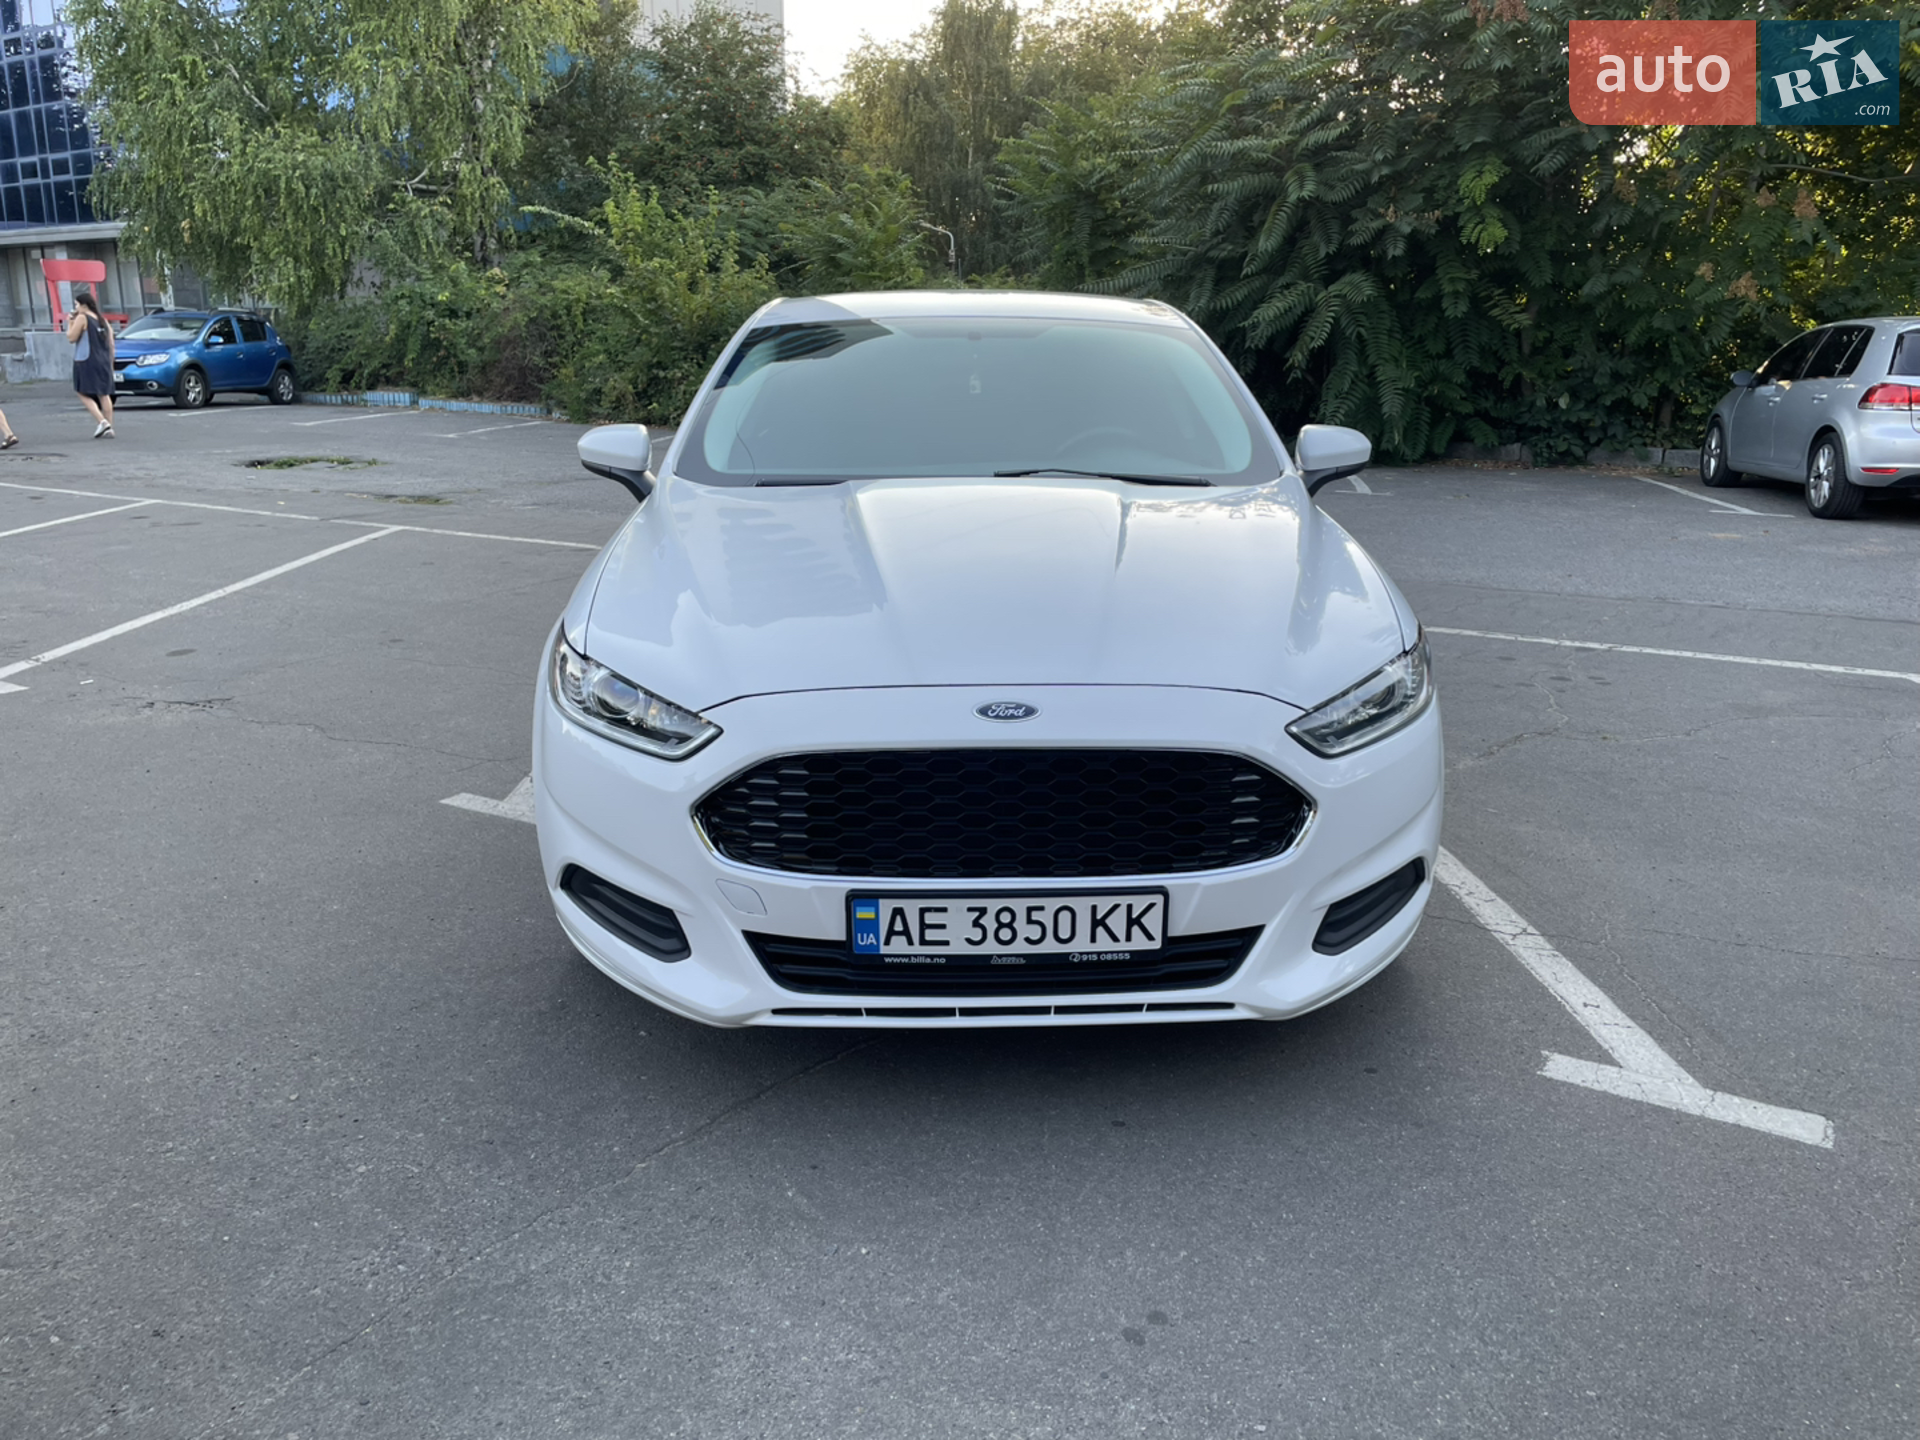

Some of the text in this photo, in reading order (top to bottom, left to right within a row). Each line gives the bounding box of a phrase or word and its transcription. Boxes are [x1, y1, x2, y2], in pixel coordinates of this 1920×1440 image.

[987, 703, 1025, 717] Ford
[883, 902, 1158, 946] AE 3850 KK
[857, 933, 877, 945] UA
